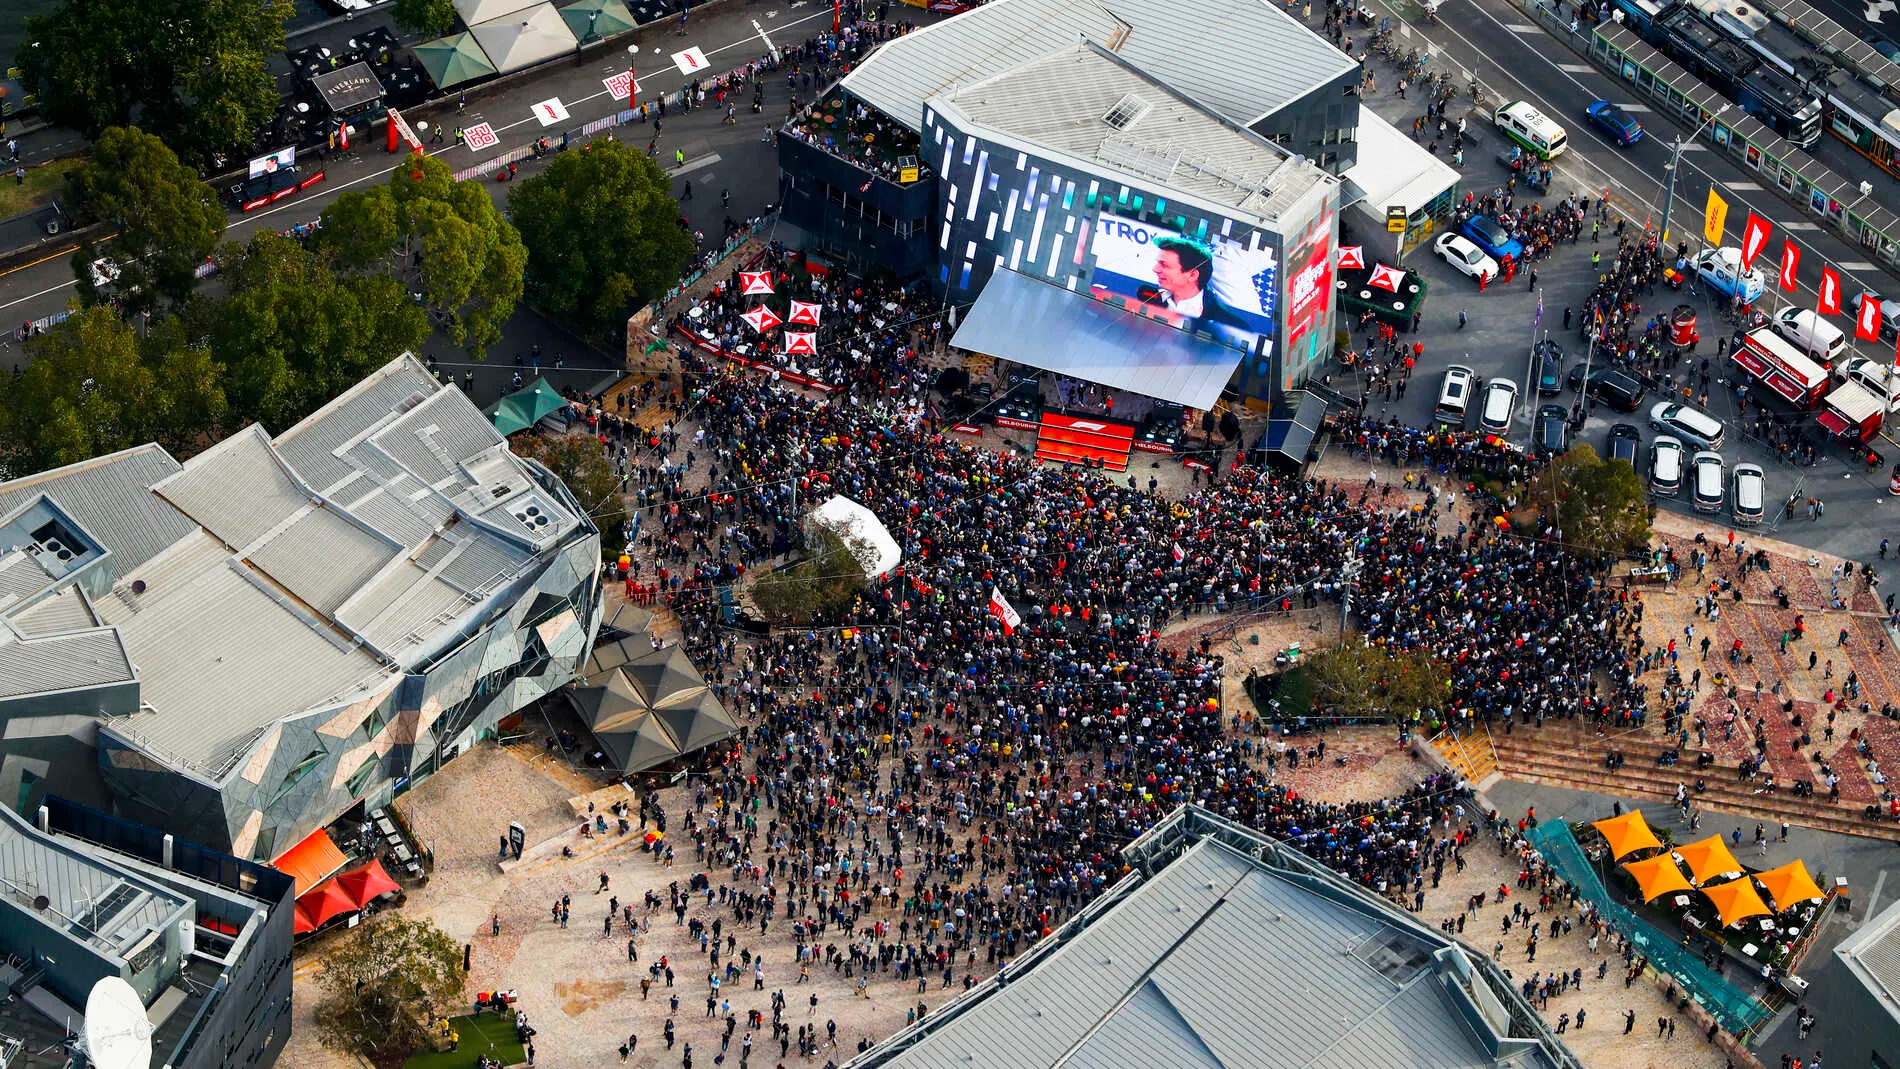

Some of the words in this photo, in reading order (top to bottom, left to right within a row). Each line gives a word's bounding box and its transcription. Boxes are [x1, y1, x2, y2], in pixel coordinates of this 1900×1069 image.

[327, 78, 370, 95] RIVERLAND
[1095, 218, 1158, 246] TRO
[1784, 366, 1801, 380] STORE
[998, 419, 1037, 430] MELBOURNE
[1134, 442, 1174, 453] MELBOURNE
